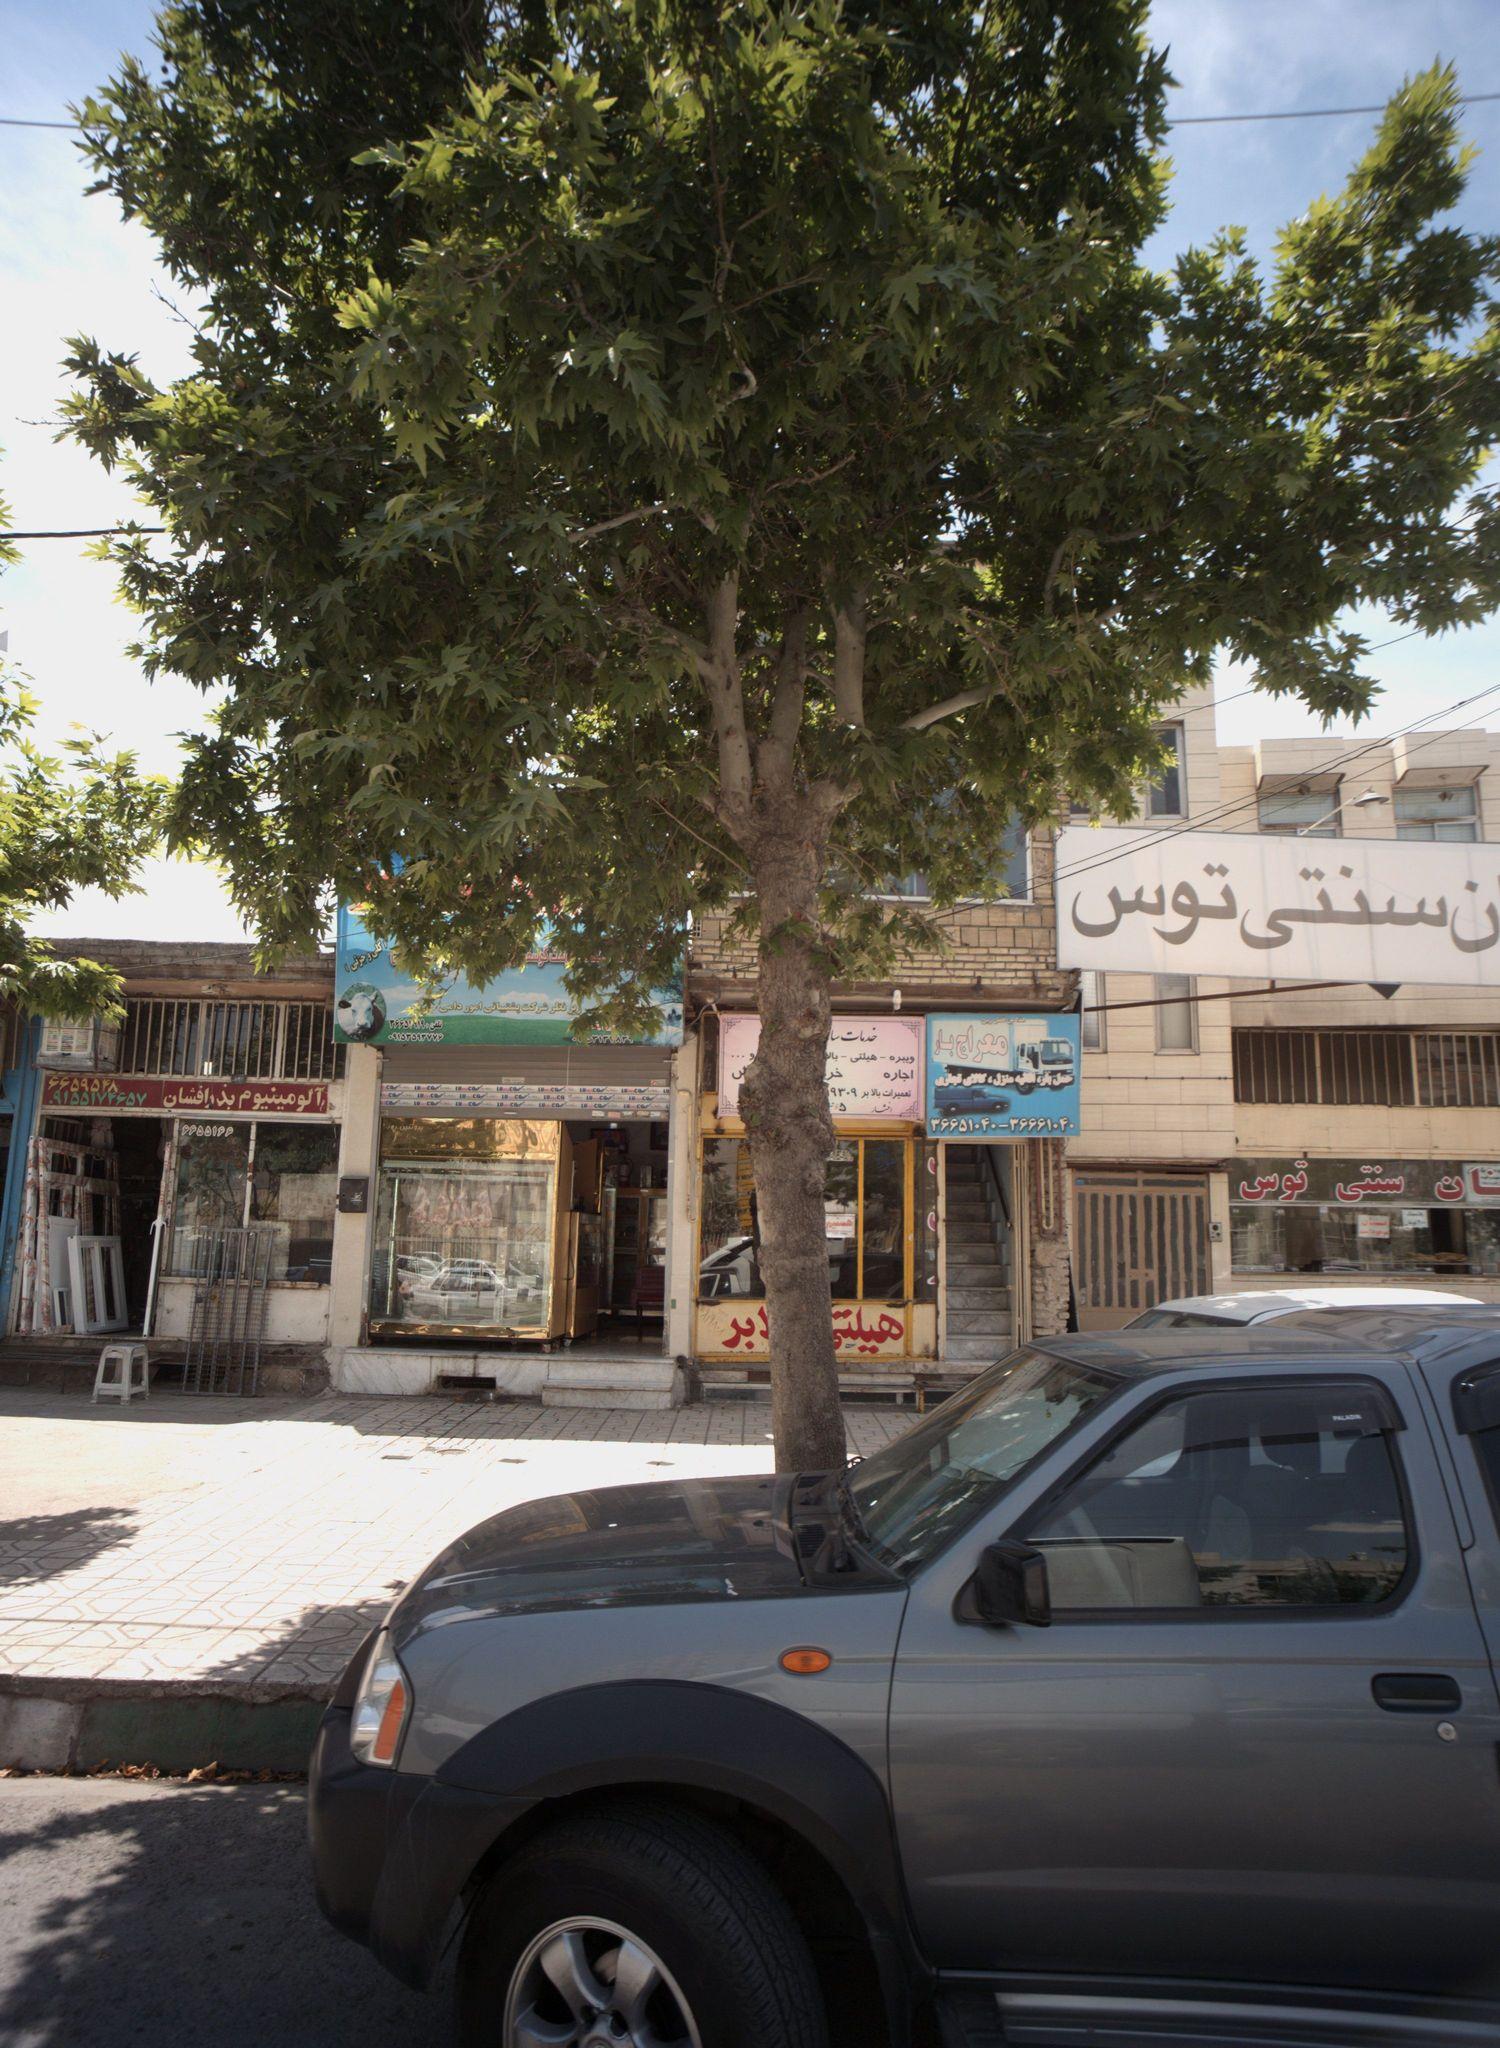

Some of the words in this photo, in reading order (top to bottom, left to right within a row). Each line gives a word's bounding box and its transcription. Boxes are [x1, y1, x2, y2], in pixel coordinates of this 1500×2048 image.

[1072, 863, 1237, 945] توس
[1240, 866, 1447, 950] سنتی
[465, 1002, 482, 1013] امور
[484, 1001, 520, 1013] پشتیبانی
[520, 1002, 548, 1013] شرکت
[550, 1001, 566, 1014] نظر
[841, 1027, 877, 1042] خدمات
[934, 1029, 954, 1057] بار
[956, 1025, 1008, 1063] معراج
[850, 1053, 877, 1063] هیلتی
[889, 1055, 915, 1064] ویبره
[884, 1069, 913, 1081] اجاره
[1053, 1074, 1075, 1086] حمل
[47, 1076, 118, 1092] ۶۶۵۹۵۴۸
[239, 1086, 325, 1112] آلومینیوم
[883, 1088, 911, 1099] تعمیرات
[1240, 1160, 1308, 1201] توس
[1336, 1165, 1404, 1202] سنتی
